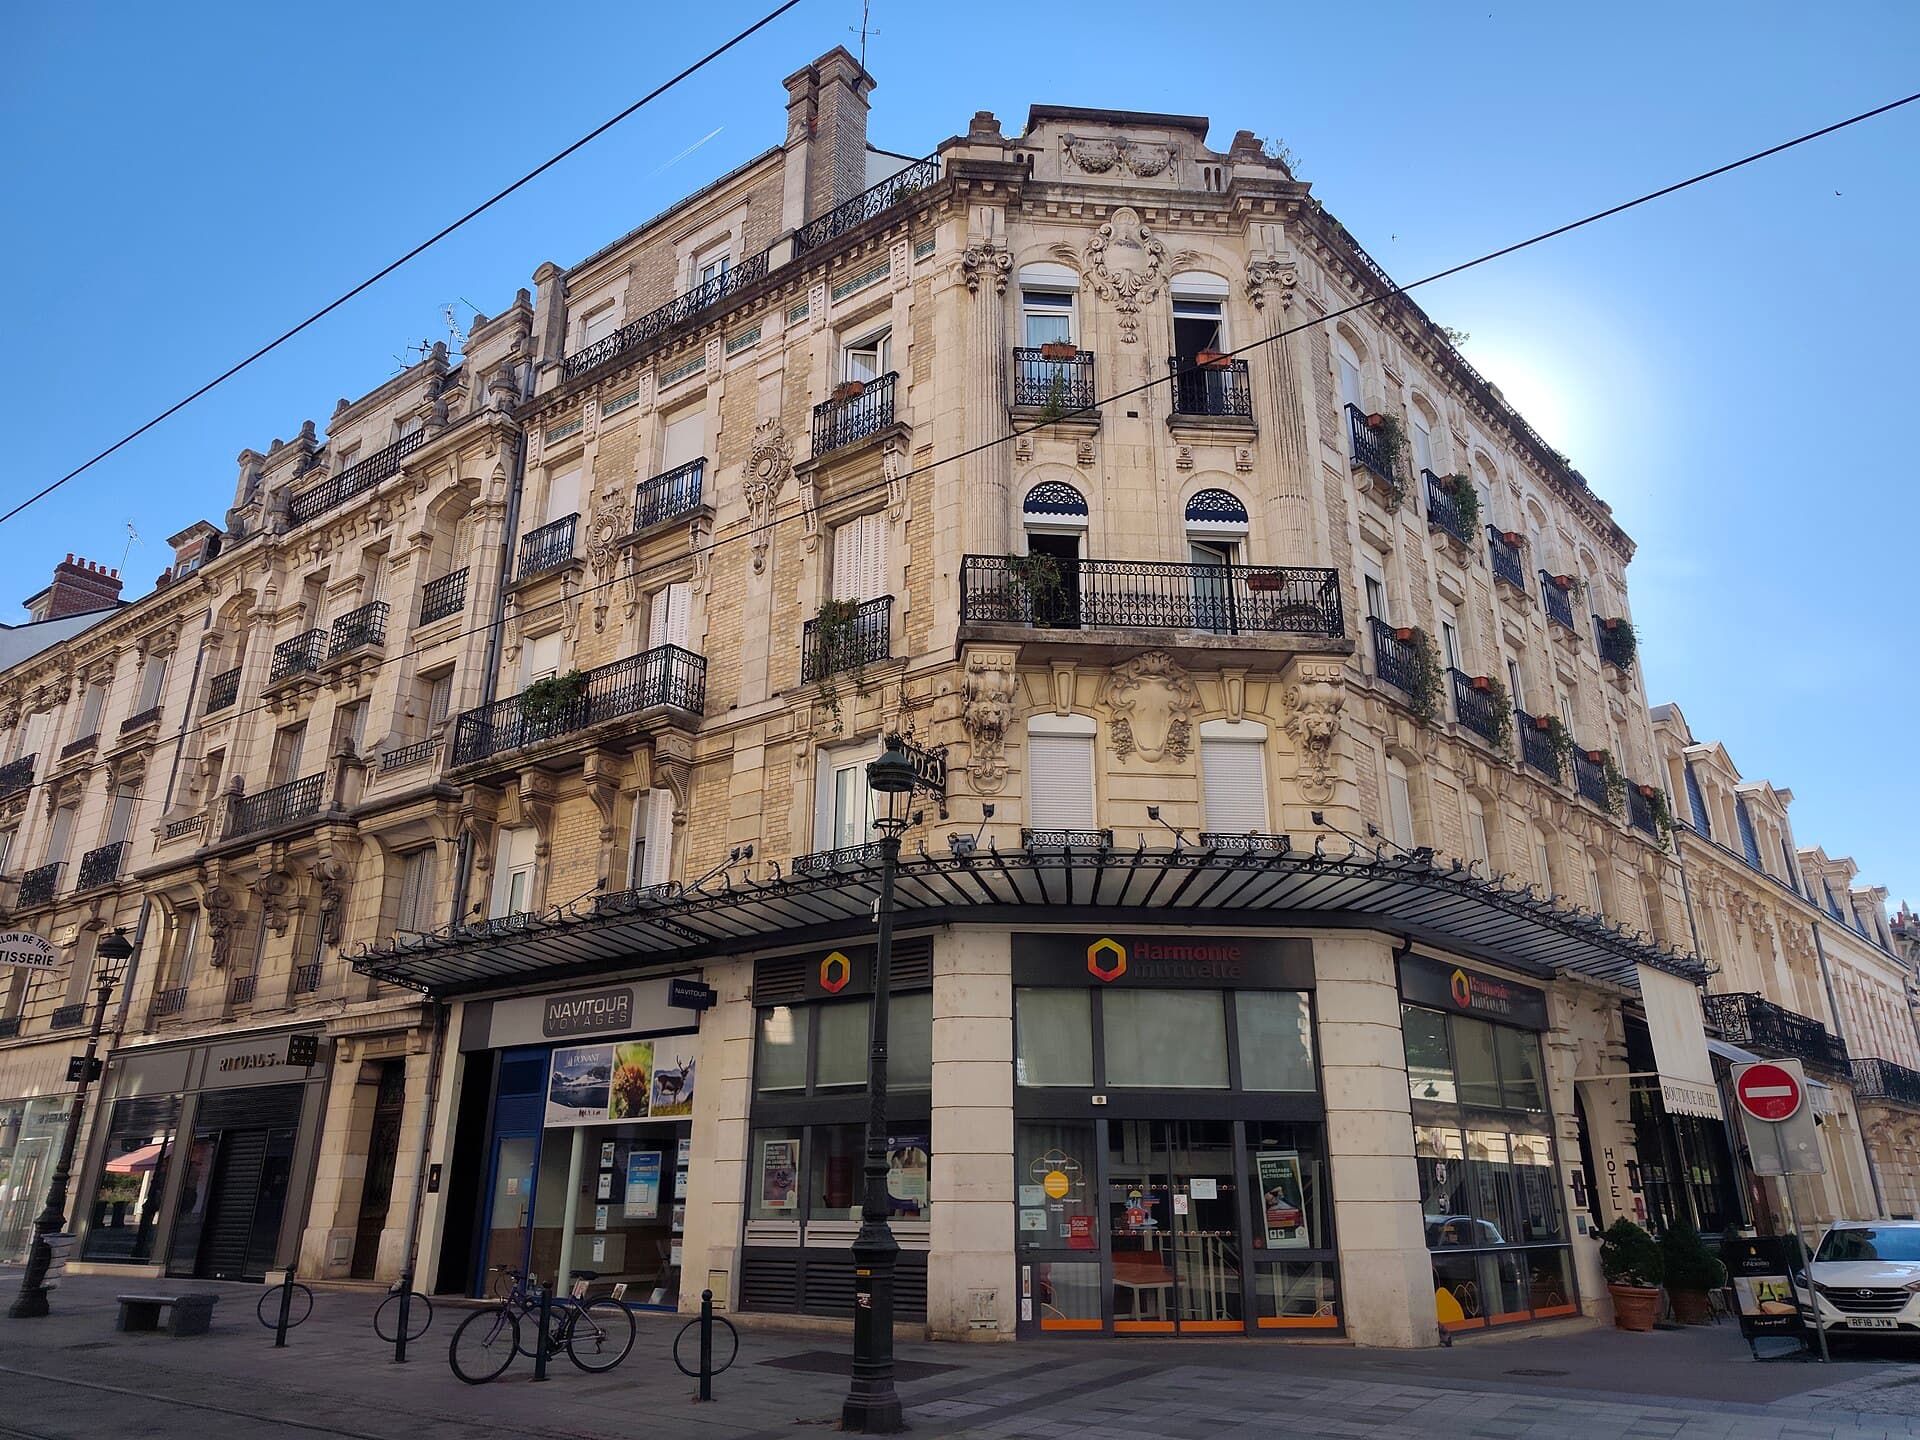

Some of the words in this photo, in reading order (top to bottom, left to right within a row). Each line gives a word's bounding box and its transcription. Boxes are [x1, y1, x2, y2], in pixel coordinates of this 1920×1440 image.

[903, 746, 946, 788] OTEL
[0, 934, 19, 944] LON
[22, 935, 34, 944] DE
[1134, 942, 1241, 960] Harmonie
[1134, 961, 1241, 978] mutuelle
[674, 987, 707, 998] NAVITOUR
[549, 995, 628, 1019] NAVITOUR
[549, 1011, 627, 1031] VOYAGES
[1604, 1147, 1622, 1210] HOTEL
[1852, 1318, 1872, 1327] RF18
